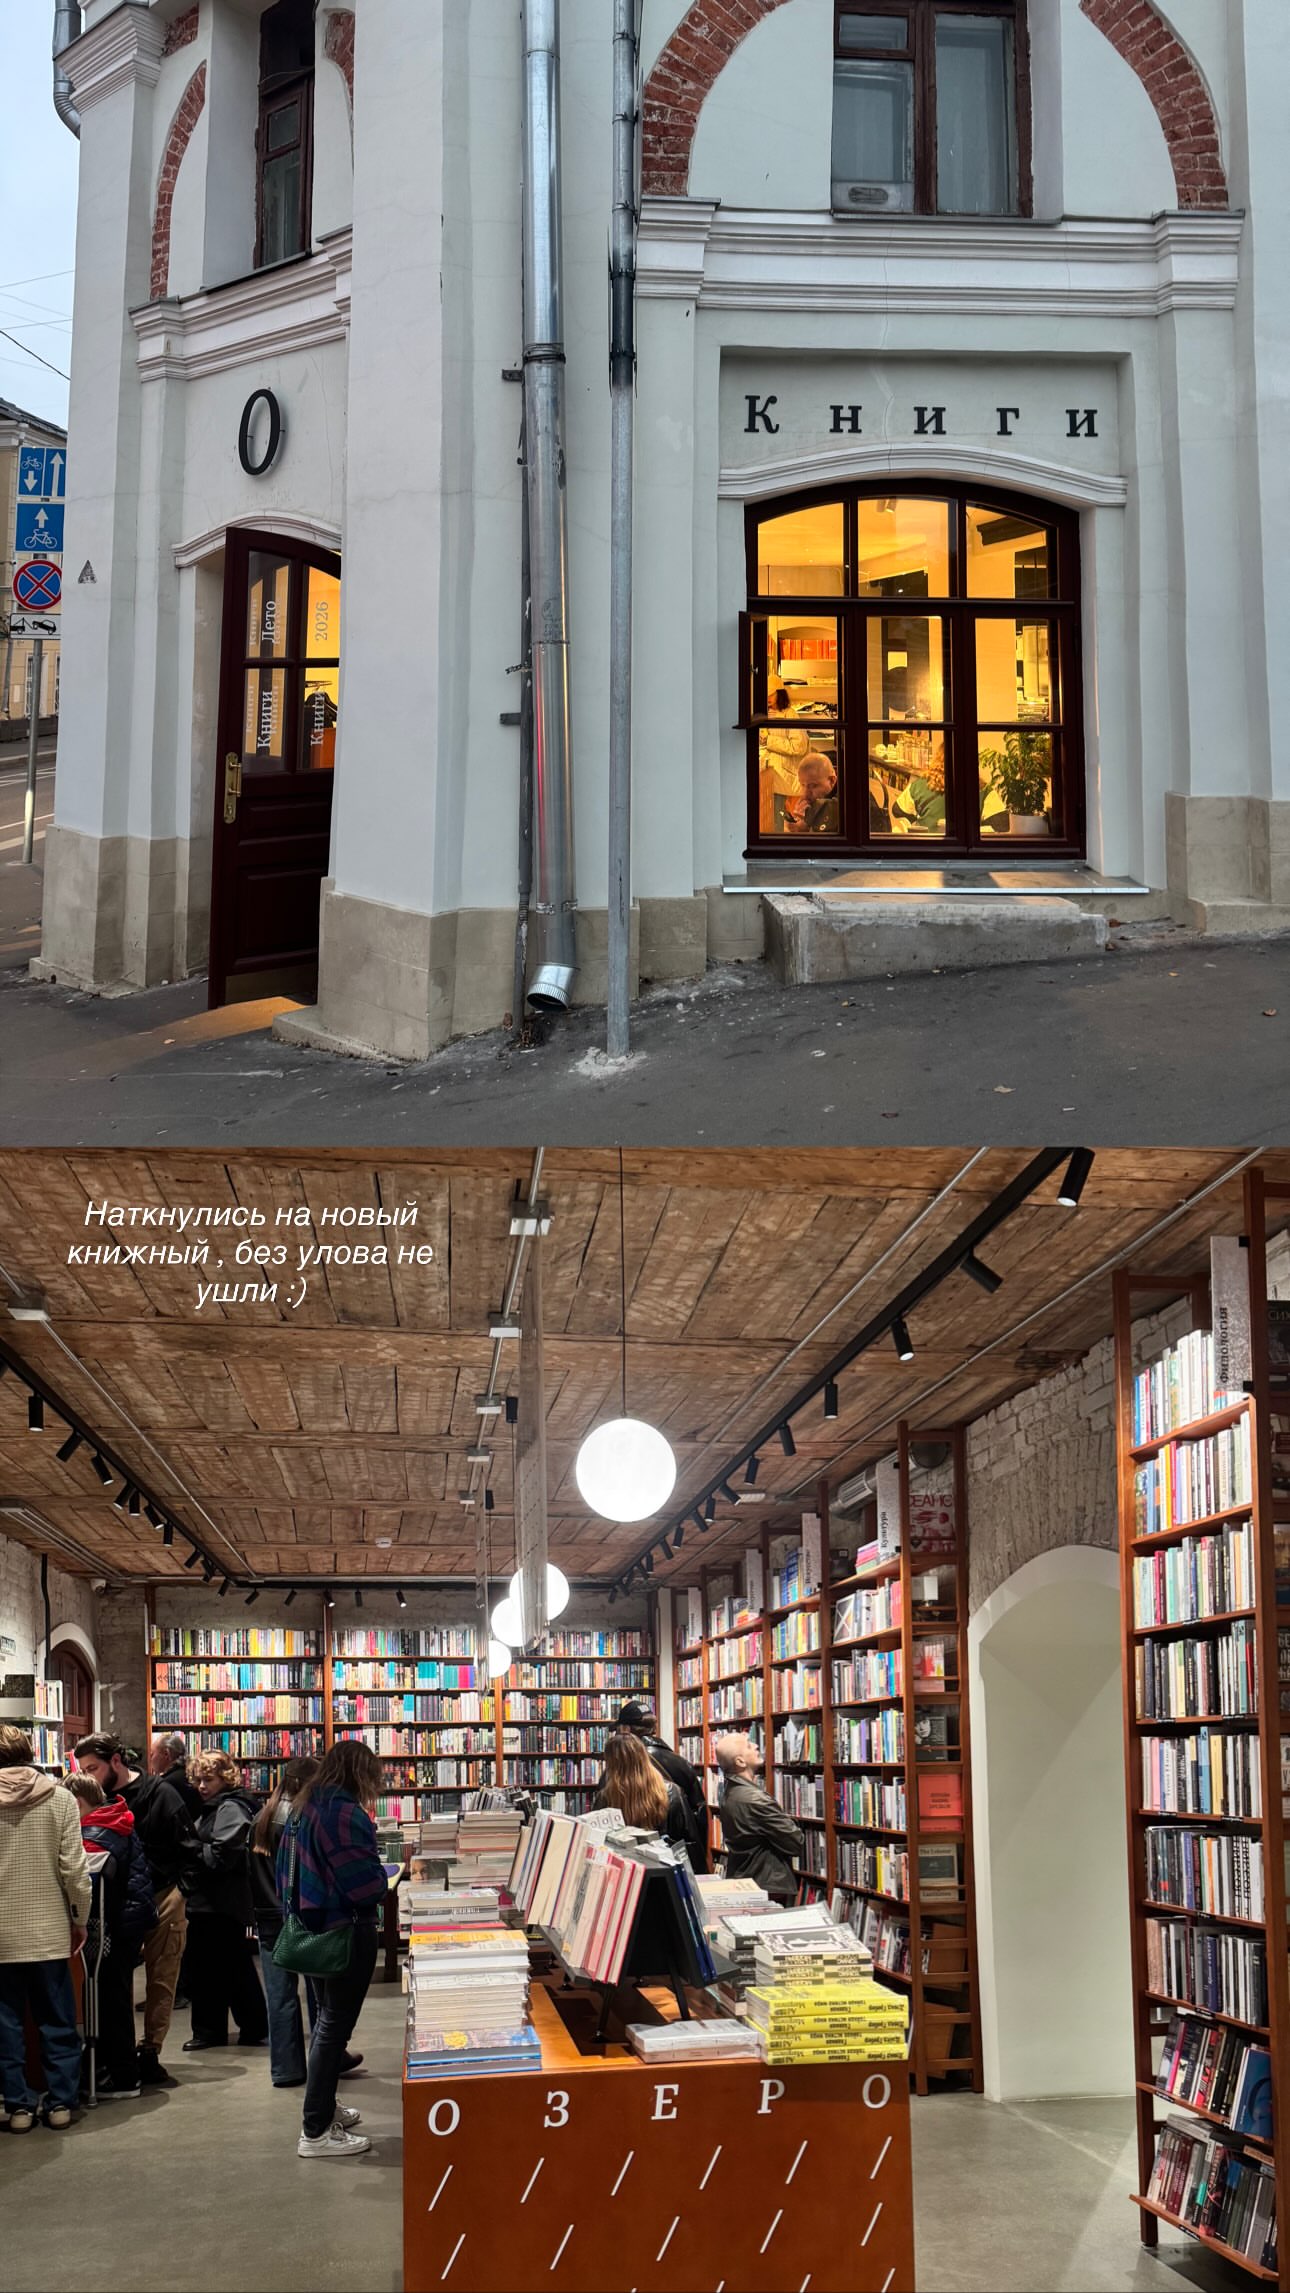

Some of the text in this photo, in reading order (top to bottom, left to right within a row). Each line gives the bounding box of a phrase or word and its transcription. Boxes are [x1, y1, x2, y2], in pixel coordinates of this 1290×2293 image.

[744, 395, 1099, 438] Книги
[261, 600, 276, 644] Лето
[315, 601, 329, 642] 2026
[257, 691, 273, 749] Книги
[310, 691, 325, 747] Книги
[1219, 1307, 1229, 1384] Филология
[428, 2074, 891, 2136] ОЗЕРО
